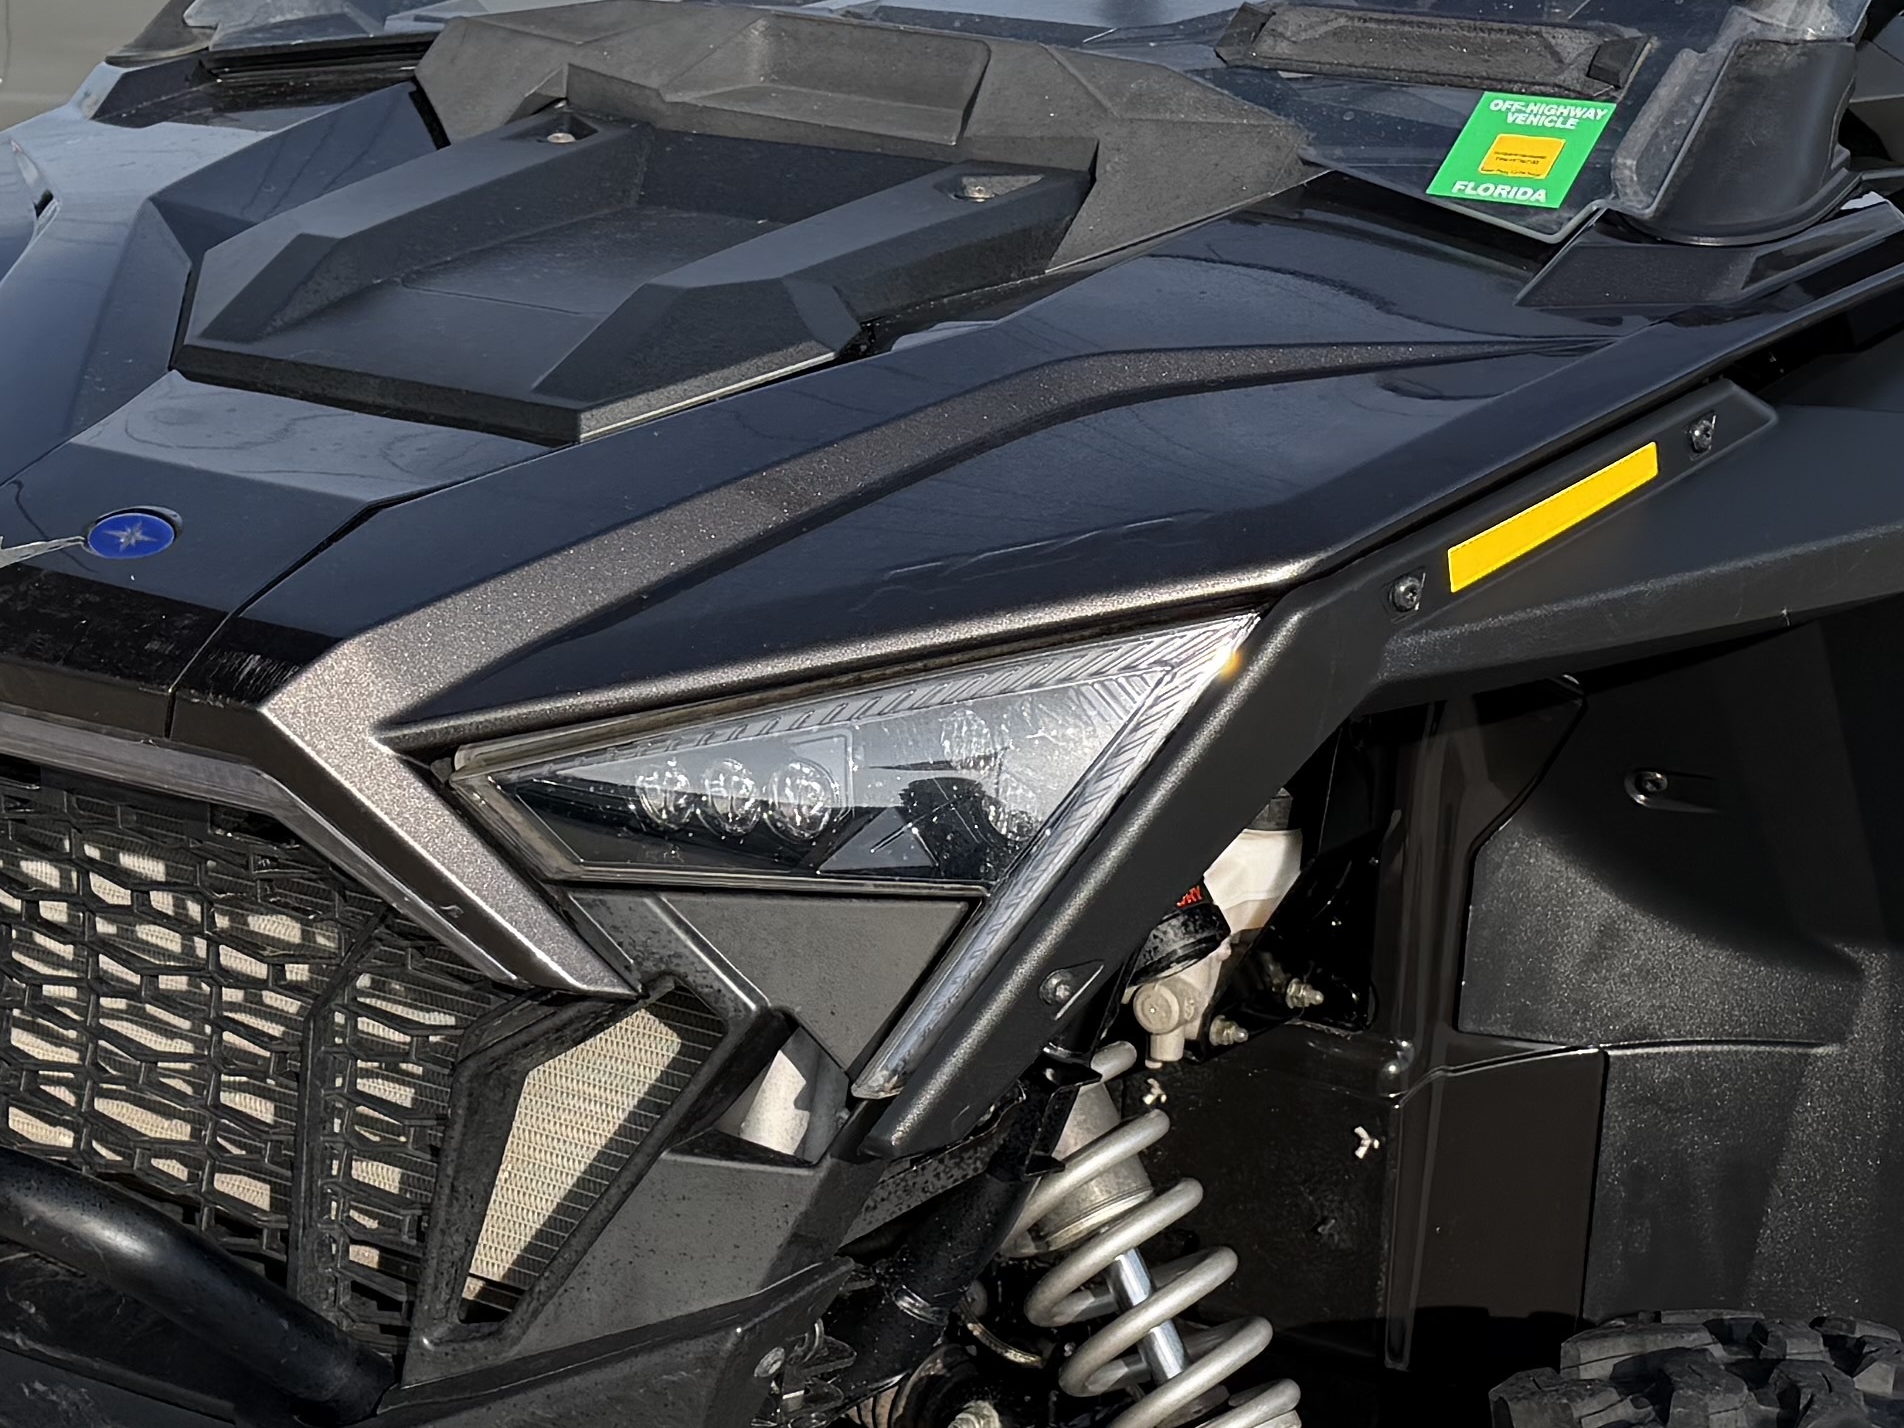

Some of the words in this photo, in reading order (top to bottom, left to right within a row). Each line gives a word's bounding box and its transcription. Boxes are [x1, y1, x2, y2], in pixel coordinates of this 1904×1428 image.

[1489, 99, 1609, 121] OFF-HIGHWAY
[1506, 112, 1580, 130] VEHICLE
[1451, 180, 1548, 203] FLORIDA
